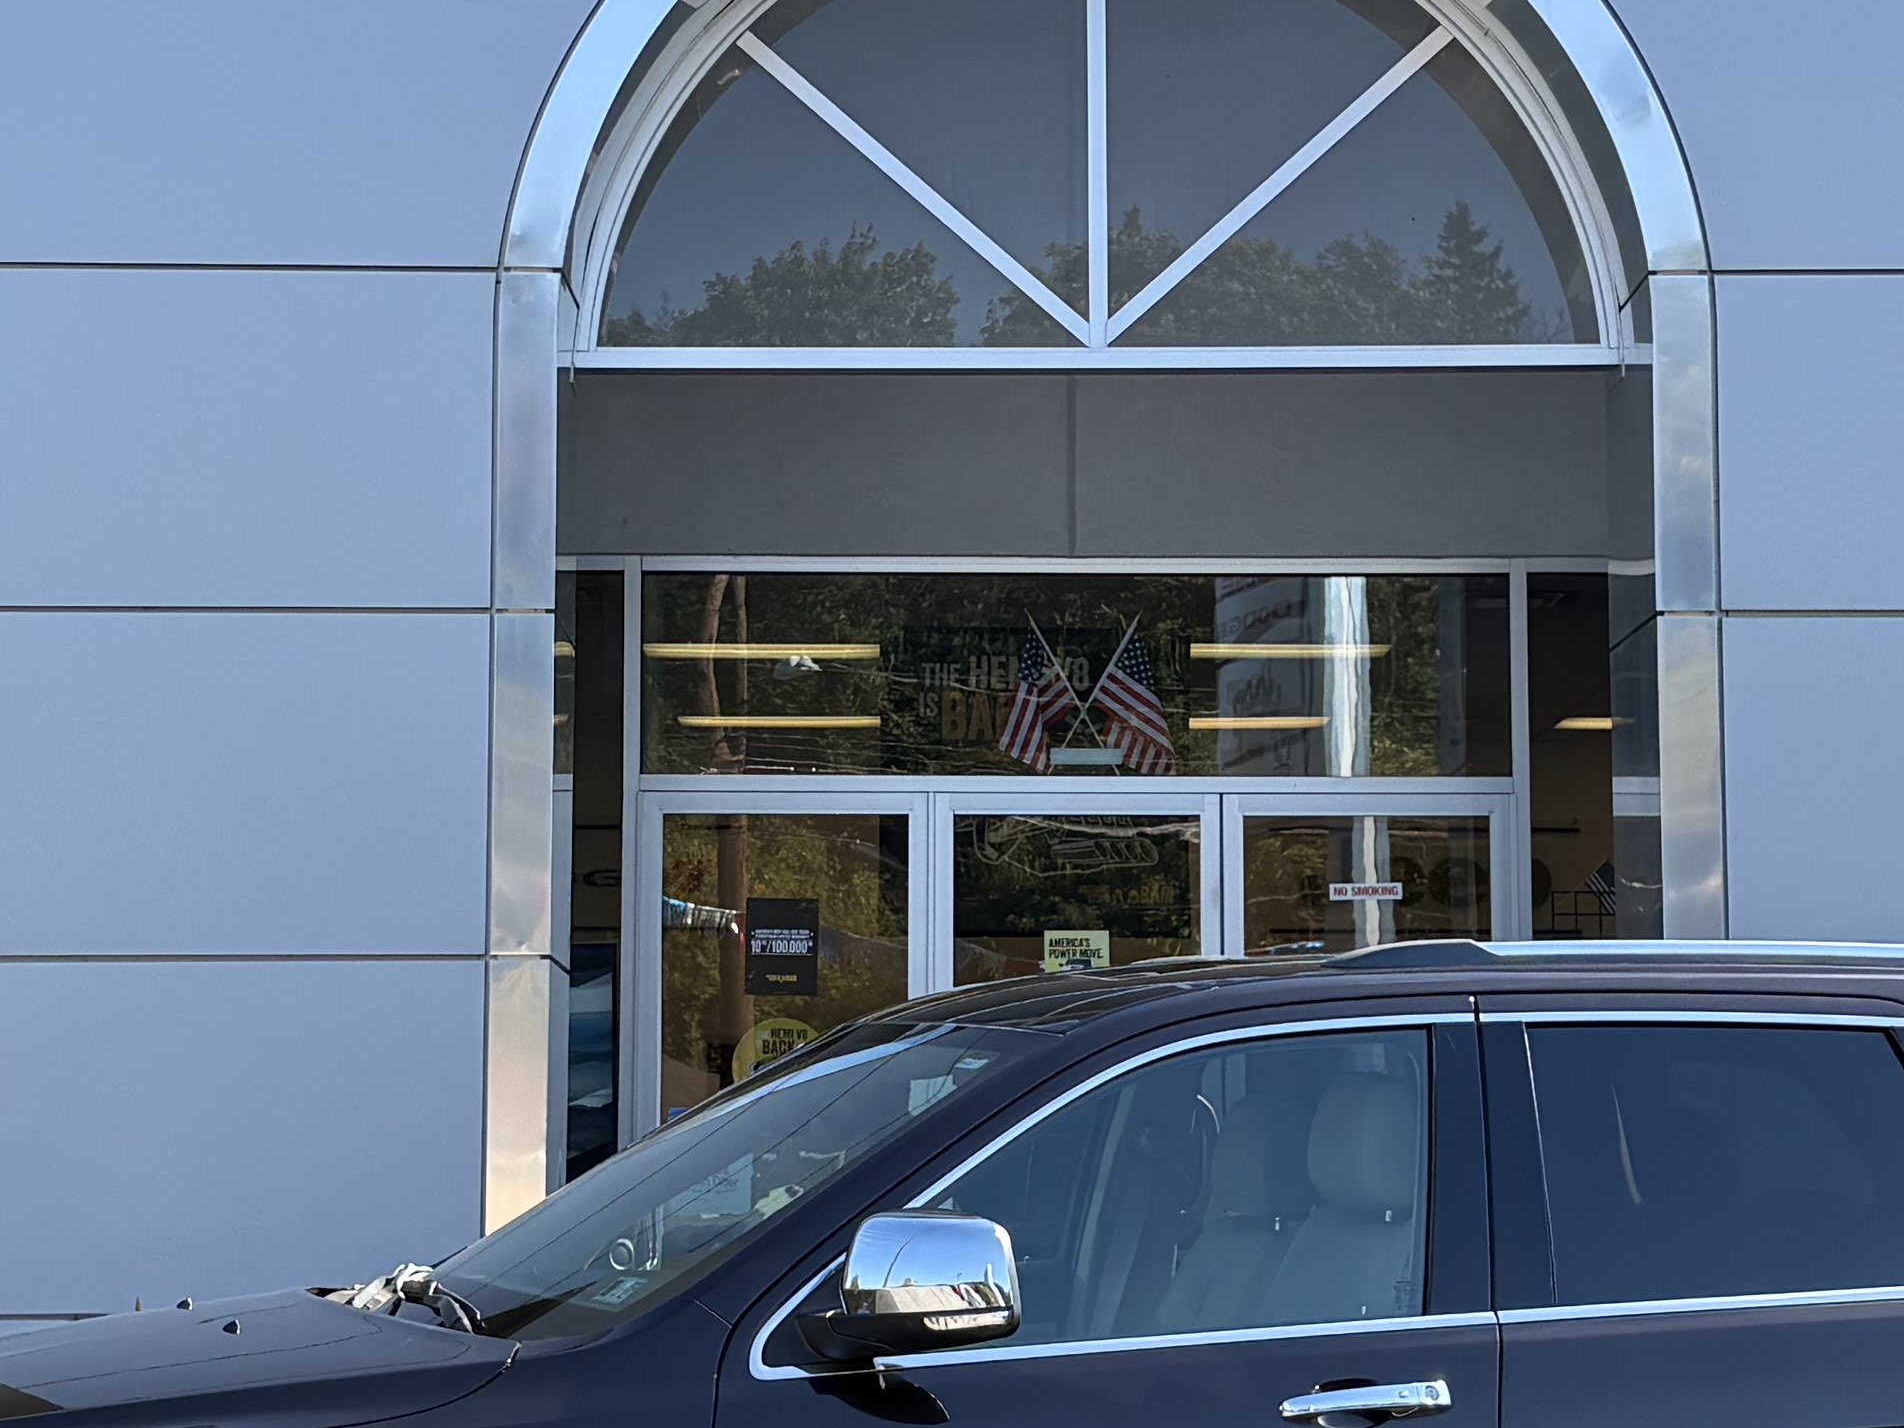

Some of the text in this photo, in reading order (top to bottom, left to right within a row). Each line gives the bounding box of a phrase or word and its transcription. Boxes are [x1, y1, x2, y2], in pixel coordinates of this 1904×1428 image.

[921, 662, 961, 688] THE
[919, 692, 939, 718] IS
[1333, 885, 1399, 897] NO SMOKING
[1048, 937, 1092, 948] AMERICA'S
[1048, 948, 1078, 959] POWER
[770, 1027, 808, 1041] HEMI V8
